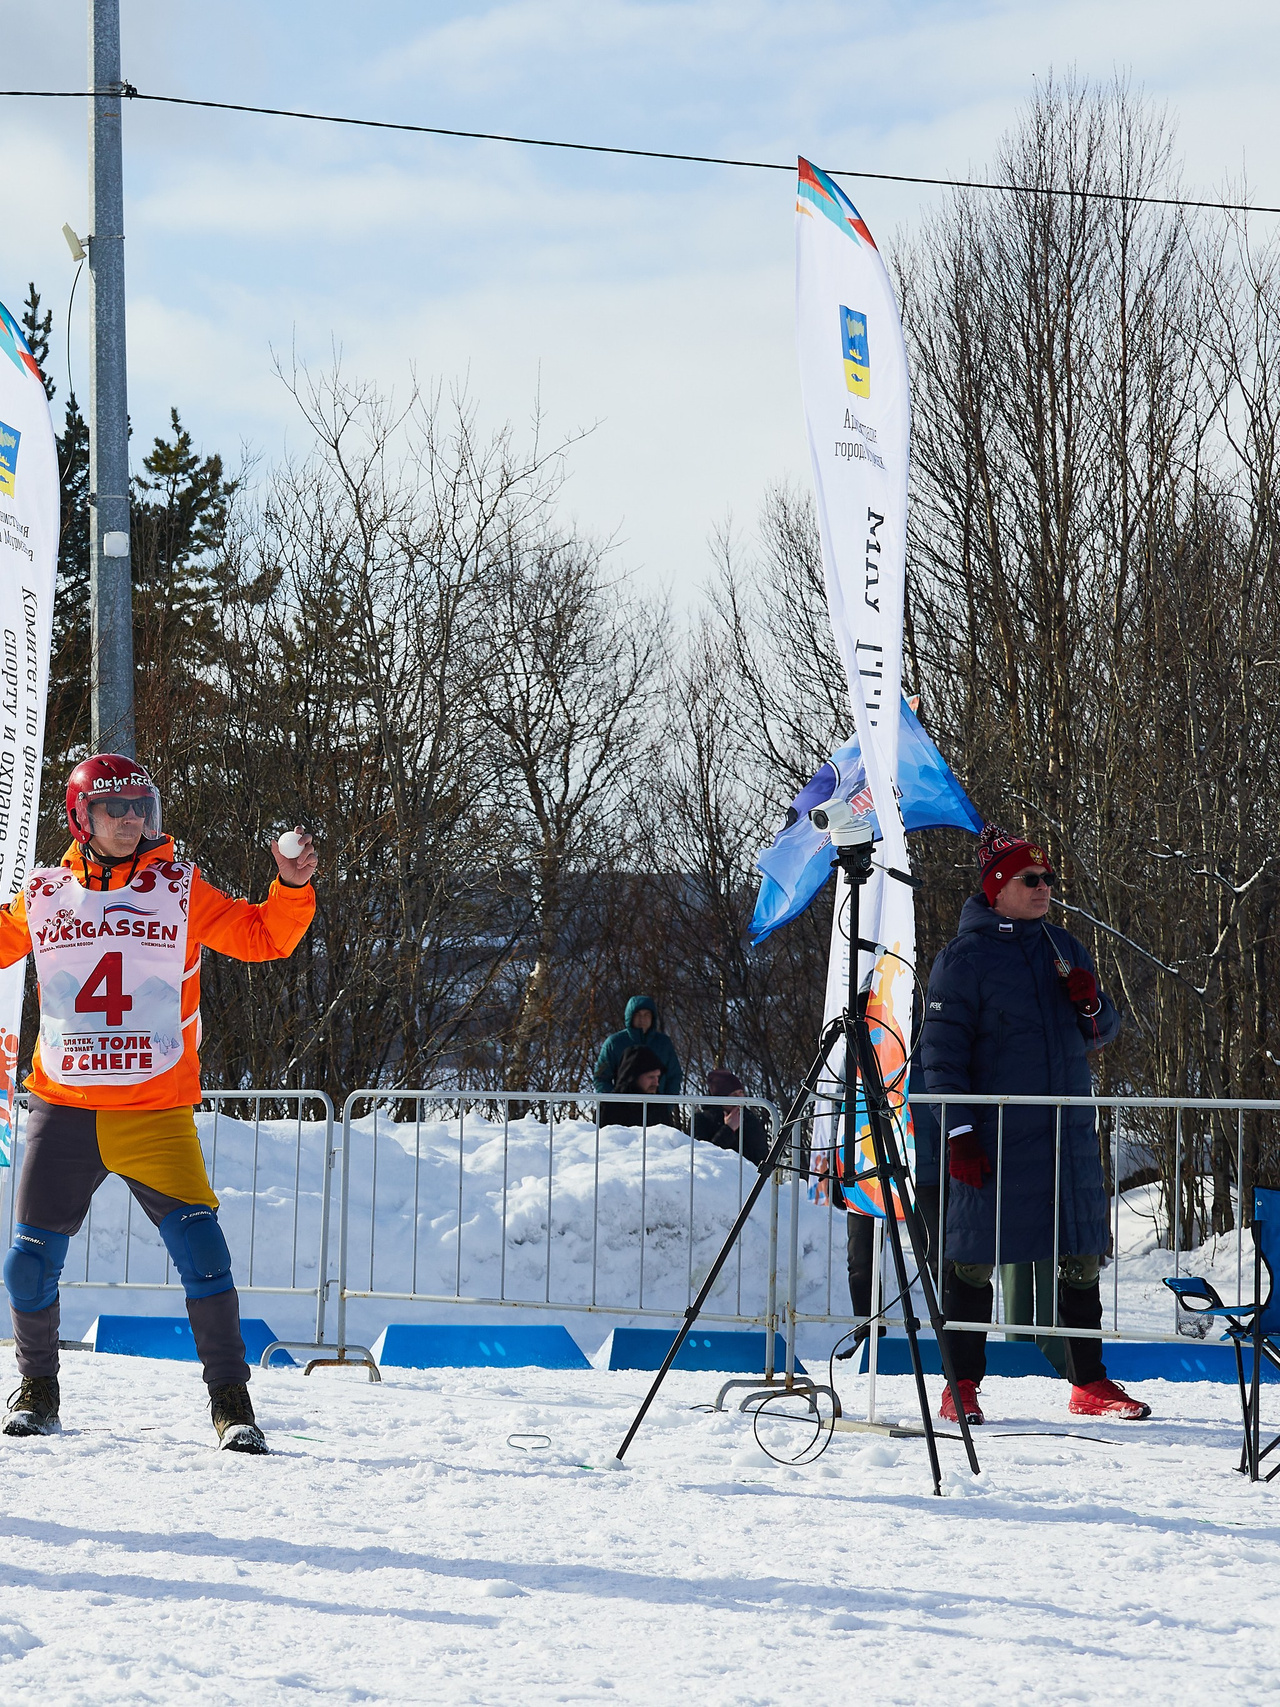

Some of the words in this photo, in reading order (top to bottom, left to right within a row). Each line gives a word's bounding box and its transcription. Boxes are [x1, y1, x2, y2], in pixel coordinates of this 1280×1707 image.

[1, 629, 18, 718] спорту
[3, 724, 16, 743] и
[25, 706, 38, 737] по
[75, 952, 132, 1026] 4
[98, 1036, 152, 1050] ТОЛК
[61, 1054, 74, 1071] В
[78, 1052, 152, 1070] СНЕГЕ
